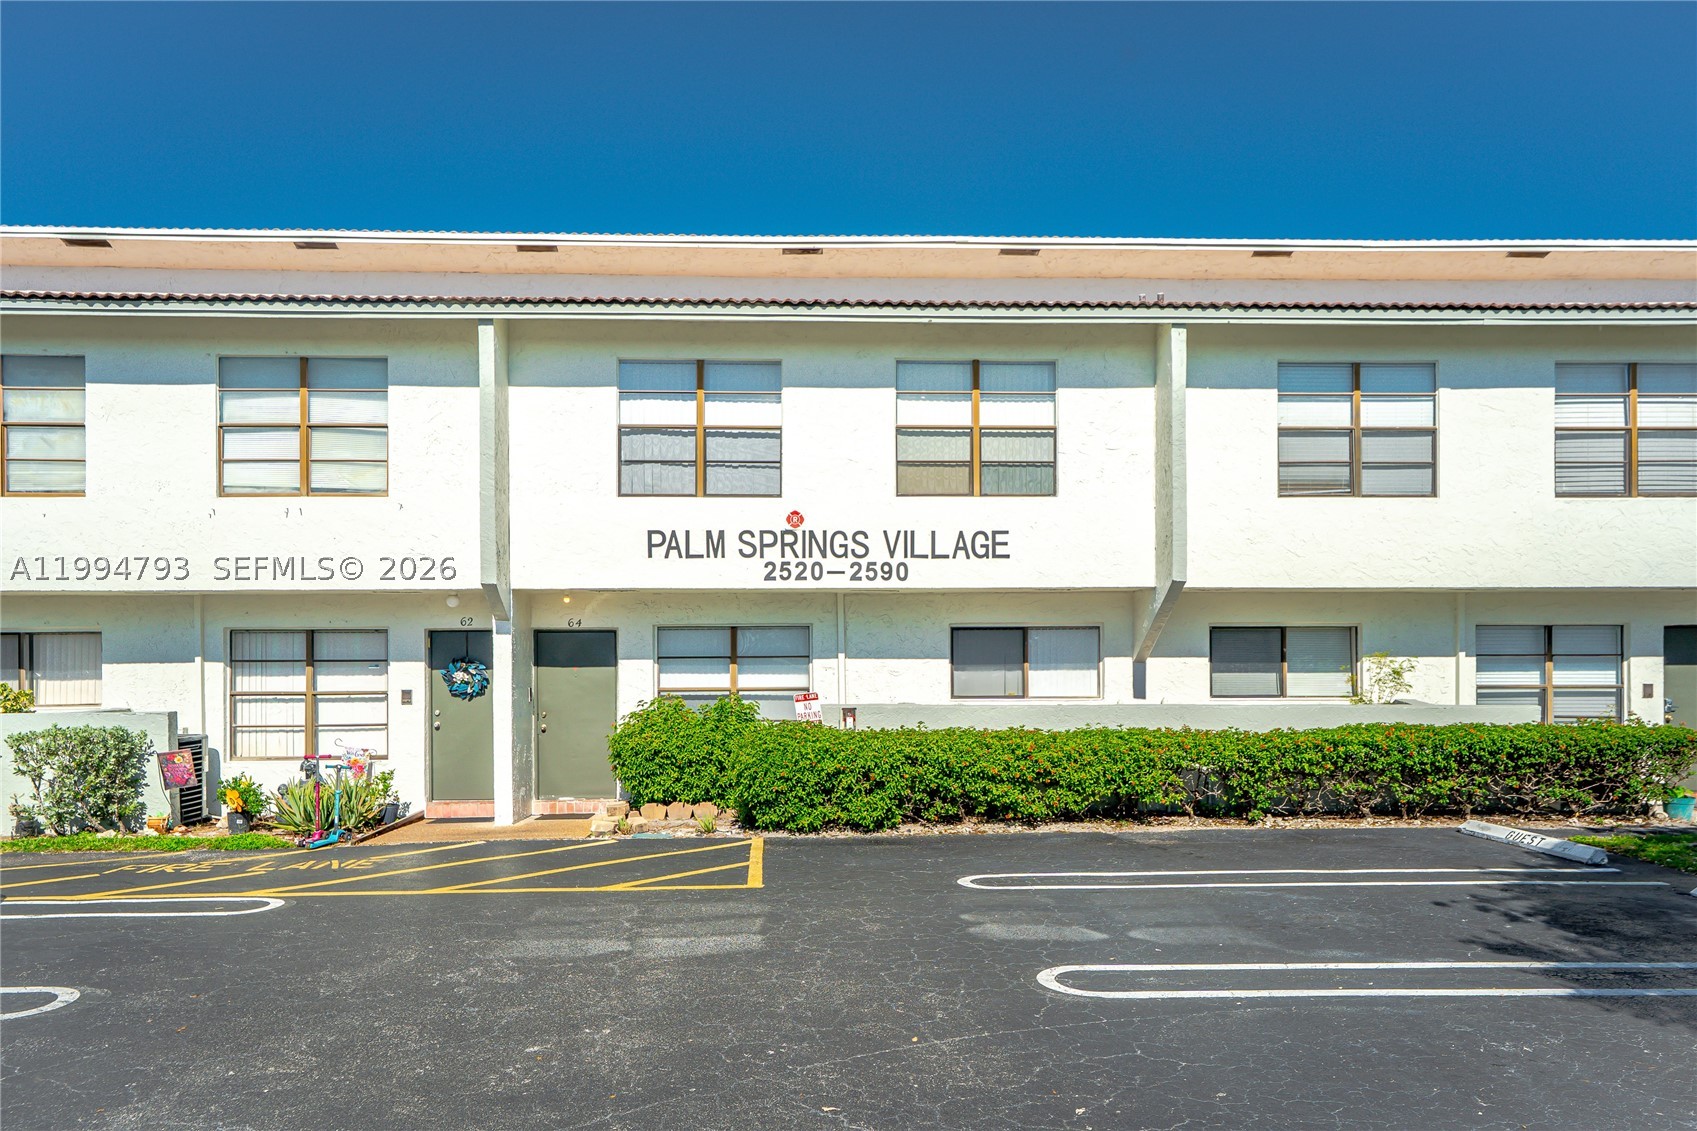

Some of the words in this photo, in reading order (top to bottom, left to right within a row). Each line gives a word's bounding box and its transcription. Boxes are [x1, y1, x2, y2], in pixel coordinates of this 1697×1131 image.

[647, 530, 725, 559] PALM
[738, 530, 870, 559] SPRINGS
[883, 530, 1011, 560] VILLAGE
[460, 616, 473, 627] 62
[567, 617, 582, 628] 64
[803, 702, 812, 710] NO
[797, 711, 821, 720] PARKING
[1505, 831, 1546, 846] GUEST
[102, 862, 231, 874] FIRE
[246, 859, 389, 871] LANE
